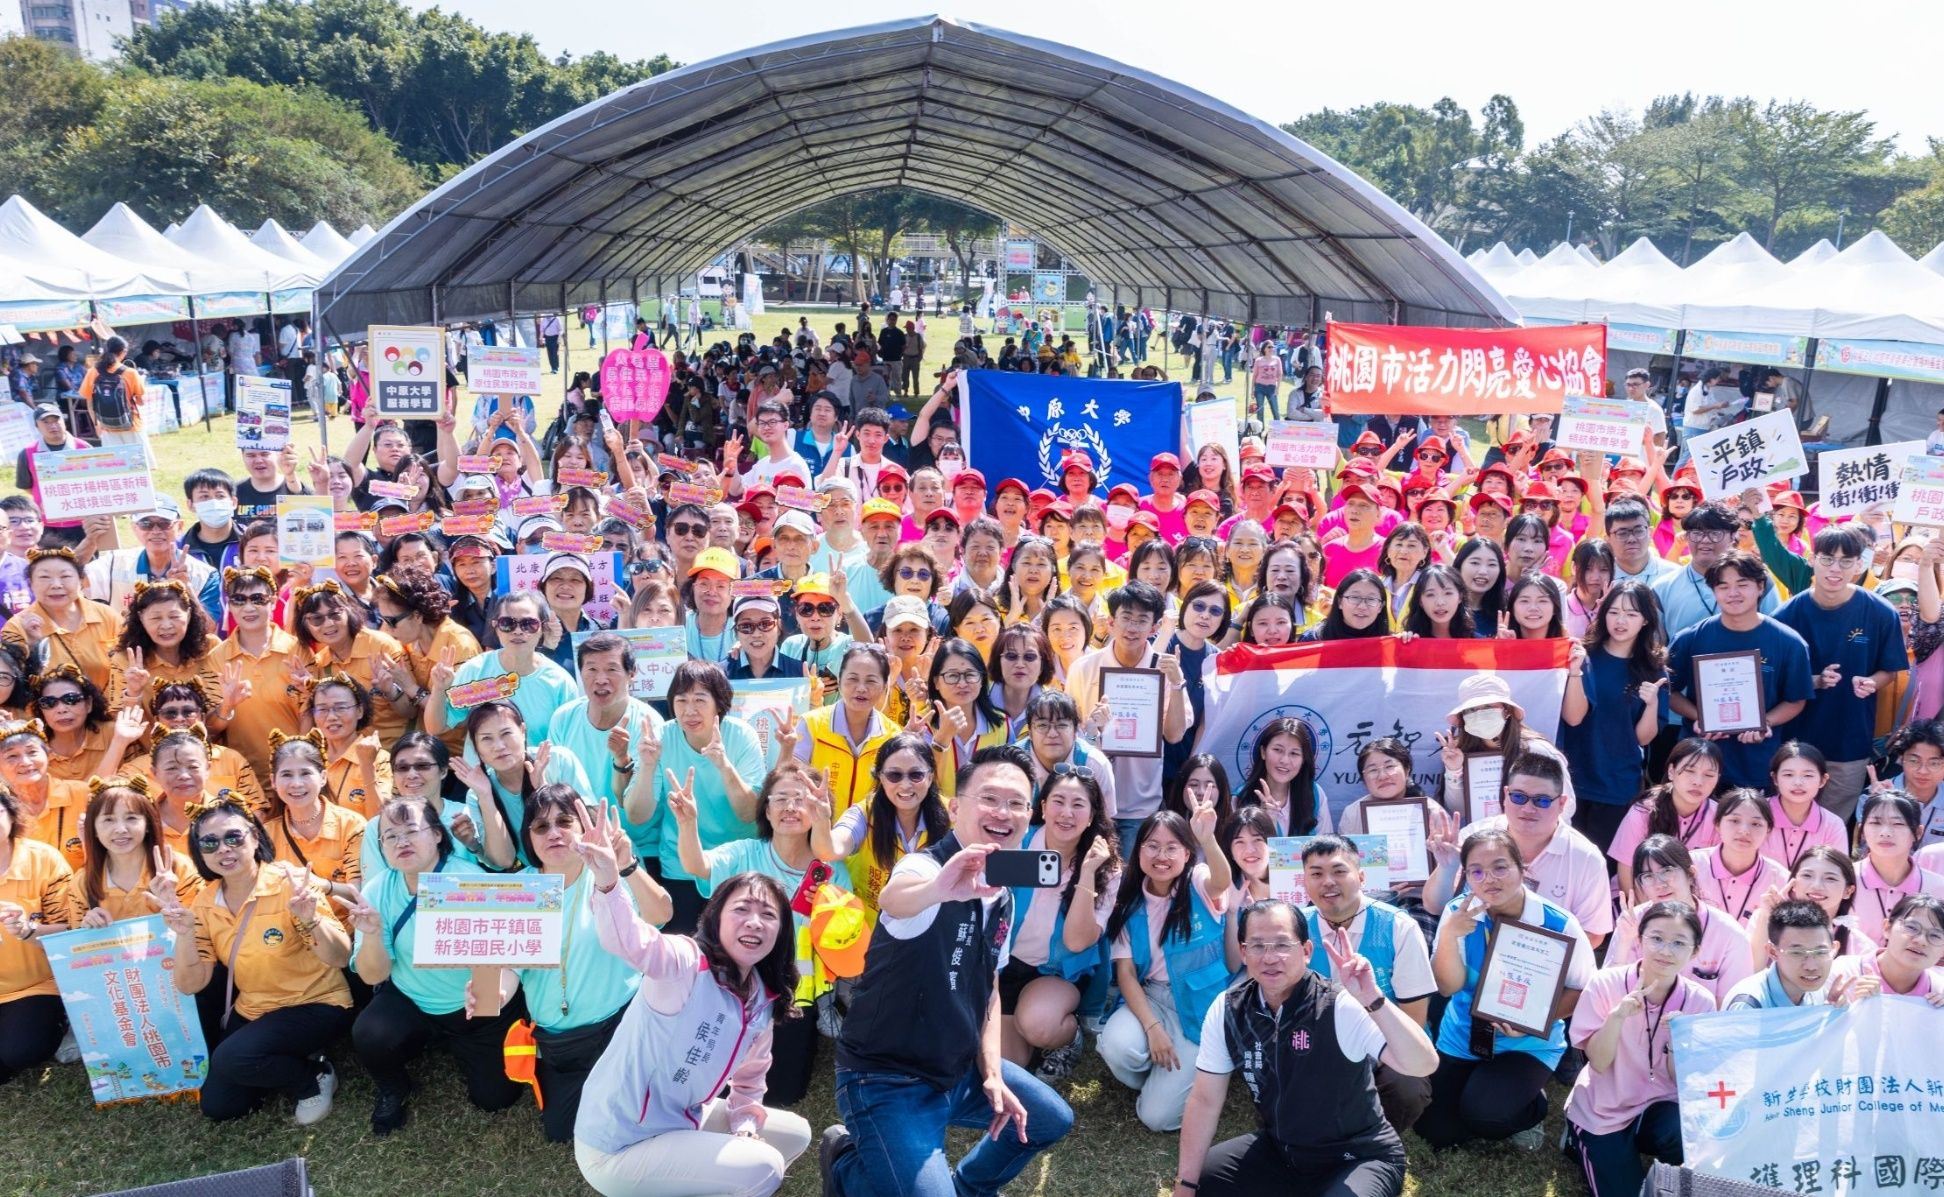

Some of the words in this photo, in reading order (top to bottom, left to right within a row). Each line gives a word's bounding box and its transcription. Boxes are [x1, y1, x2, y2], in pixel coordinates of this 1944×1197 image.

[1328, 344, 1605, 399] 桃園市活力閃亮愛心協會
[386, 385, 432, 396] 中原大學
[386, 397, 432, 408] 服務學習
[1017, 397, 1132, 427] 中原大學
[1711, 428, 1765, 464] 平鎮
[1721, 456, 1768, 490] 戶政
[1836, 453, 1891, 488] 熱情
[44, 476, 148, 497] 桃園市楊梅區新梅
[237, 504, 255, 516] LIFE
[435, 918, 543, 935] 桃園市平鎮區
[434, 939, 542, 956] 新勢國民小學
[104, 970, 137, 1049] 文化基金會
[125, 967, 173, 1069] 財團法人桃園市
[1783, 1105, 1815, 1118] Sheng
[1820, 1102, 1851, 1114] Junior
[1858, 1100, 1904, 1113] College
[1910, 1101, 1923, 1112] of
